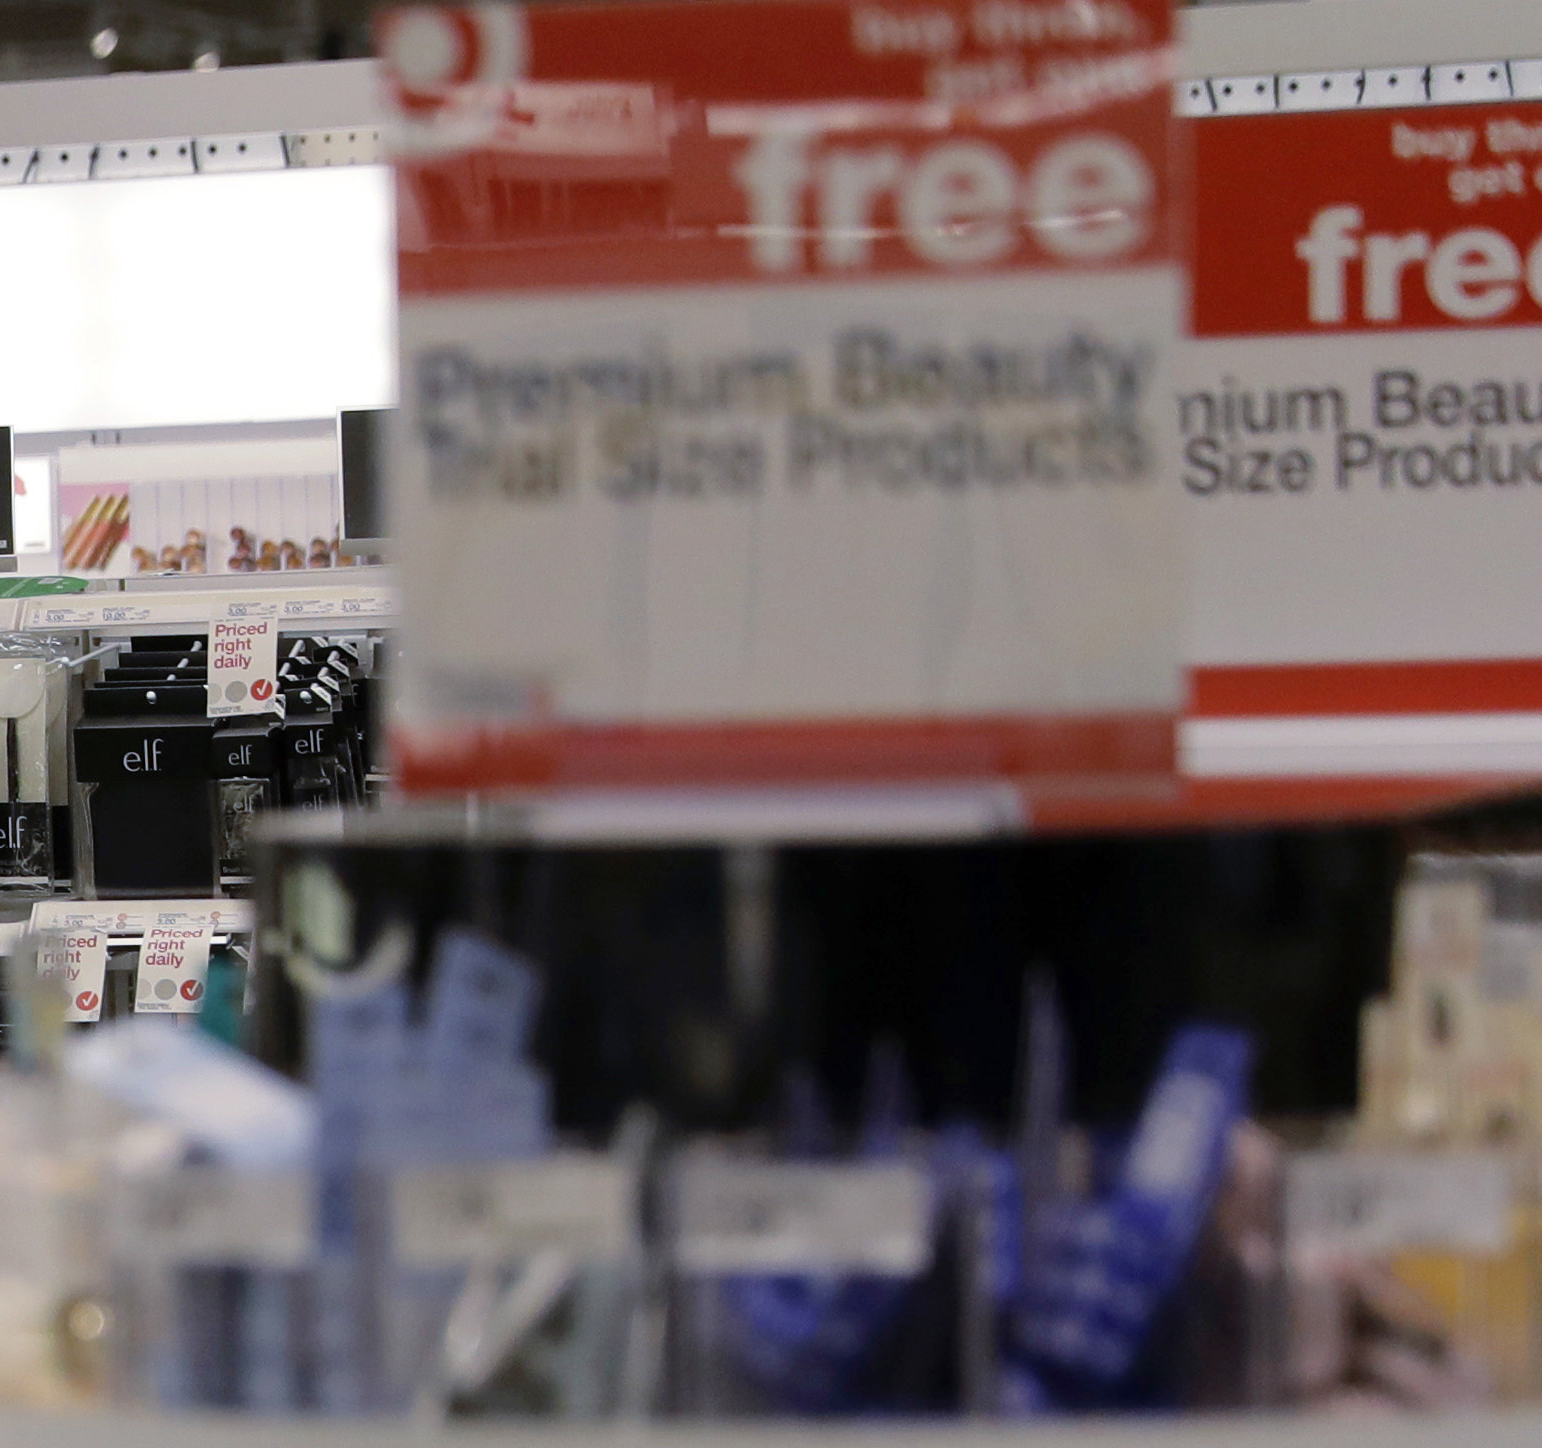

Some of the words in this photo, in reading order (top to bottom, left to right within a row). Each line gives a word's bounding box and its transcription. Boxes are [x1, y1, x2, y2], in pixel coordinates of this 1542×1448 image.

[733, 122, 1156, 274] free
[1295, 204, 1542, 322] fre
[1182, 437, 1311, 495] Size
[215, 622, 267, 637] Priced
[214, 639, 252, 654] right
[214, 655, 252, 670] daily
[150, 928, 203, 938] Priced
[148, 939, 185, 953] right
[145, 953, 184, 968] daily
